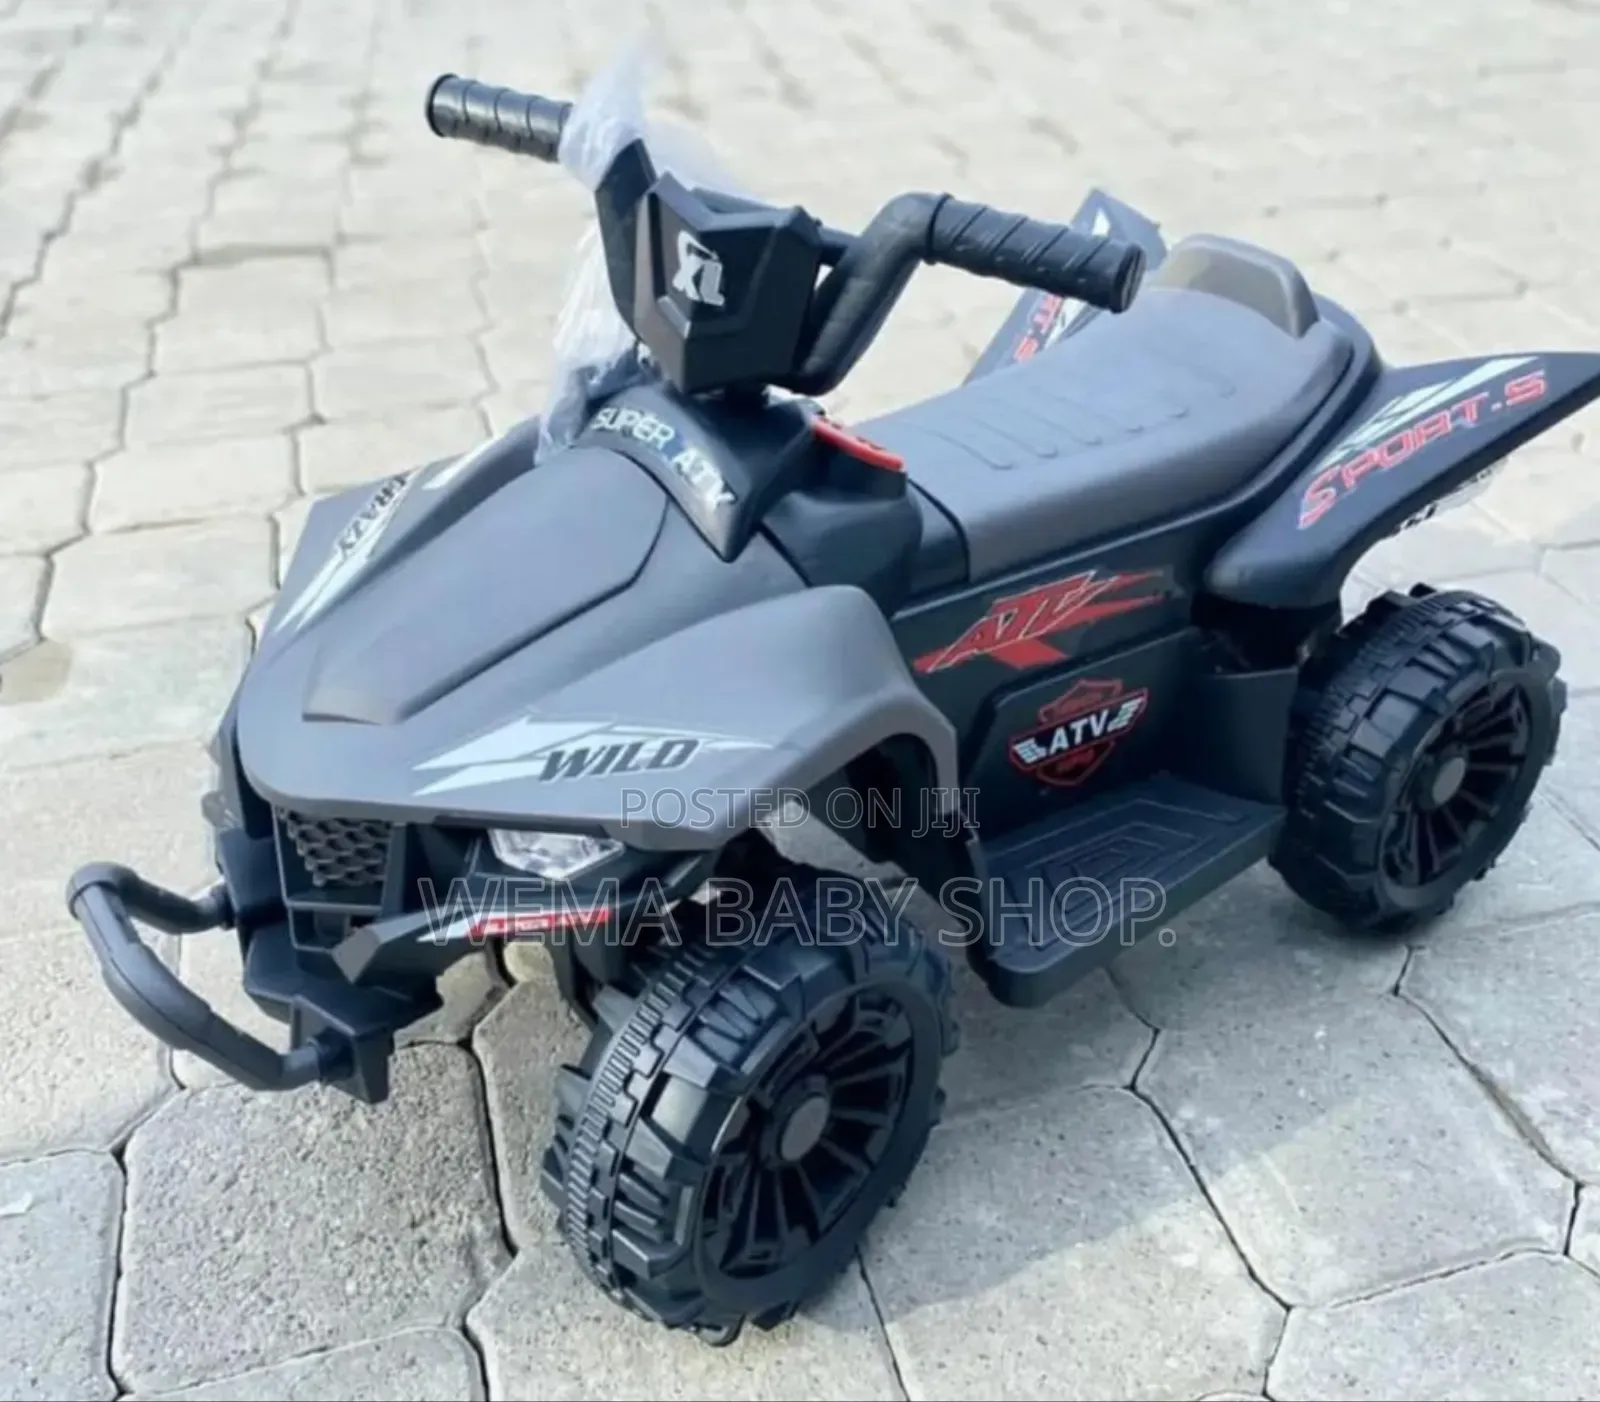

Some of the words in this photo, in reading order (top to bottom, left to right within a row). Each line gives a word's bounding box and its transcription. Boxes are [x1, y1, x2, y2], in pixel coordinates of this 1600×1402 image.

[591, 406, 675, 450] SUPER
[1048, 709, 1110, 753] ATV
[538, 738, 701, 783] WILD
